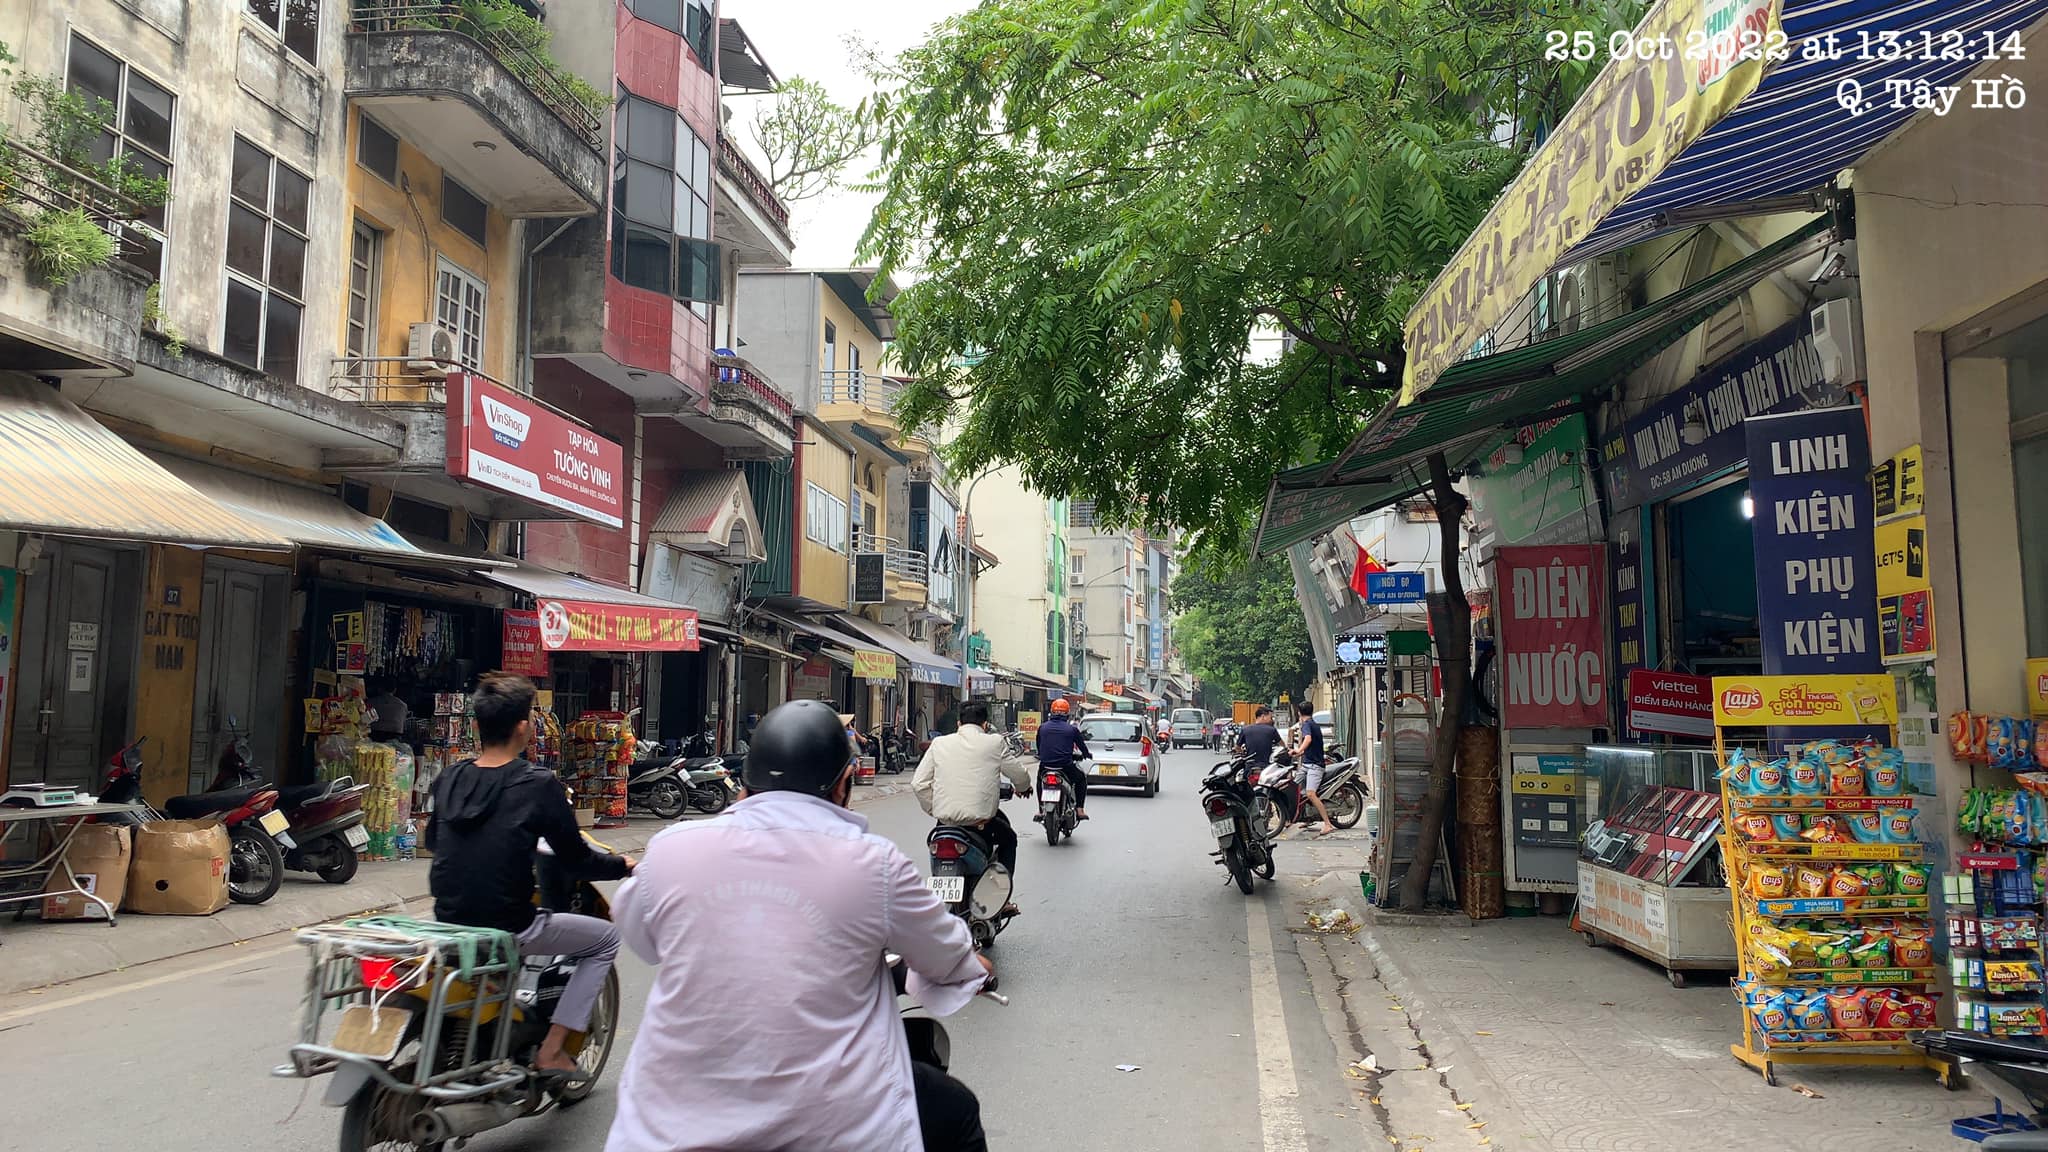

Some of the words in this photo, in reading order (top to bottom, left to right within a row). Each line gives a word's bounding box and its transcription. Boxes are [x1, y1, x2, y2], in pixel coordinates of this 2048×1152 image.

[1634, 425, 1659, 470] MUA
[1654, 411, 1680, 460] BÁN
[1707, 373, 1746, 434] CHỮA
[1742, 356, 1780, 415] ĐIỆN
[1775, 334, 1825, 398] THOẠ
[489, 403, 523, 436] VinShop
[567, 429, 582, 450] TẠP
[583, 437, 599, 457] HÓA
[1771, 434, 1849, 476] LINH
[554, 449, 589, 481] TƯỜNG
[590, 465, 611, 491] VINH
[1775, 490, 1856, 540] KIỆN
[1619, 526, 1629, 555] ÉP
[1877, 550, 1904, 568] LET'S
[1617, 565, 1636, 593] KÍNH
[1785, 556, 1855, 600] PHỤ
[168, 590, 178, 602] 37
[1511, 556, 1590, 629] ĐIỆN
[546, 611, 562, 630] 37
[1618, 602, 1638, 629] THAY
[616, 614, 633, 647] TẠP
[1785, 611, 1867, 663] KIỆN
[155, 643, 184, 671] NAM
[1362, 650, 1384, 660] Mobile
[1620, 636, 1639, 665] MÀN
[1507, 642, 1601, 706] NƯỚC
[1652, 679, 1700, 695] viettel
[1634, 692, 1660, 706] ĐIỂM
[1661, 697, 1683, 709] BÁN
[1685, 700, 1713, 713] HÀNG
[1725, 688, 1761, 710] Lay's
[1779, 687, 1797, 700] Số
[1797, 683, 1808, 700] 1
[1775, 698, 1803, 716] giòn
[1806, 700, 1842, 716] ngon
[933, 879, 957, 889] 88-K1
[1768, 903, 1793, 913] Ngon
